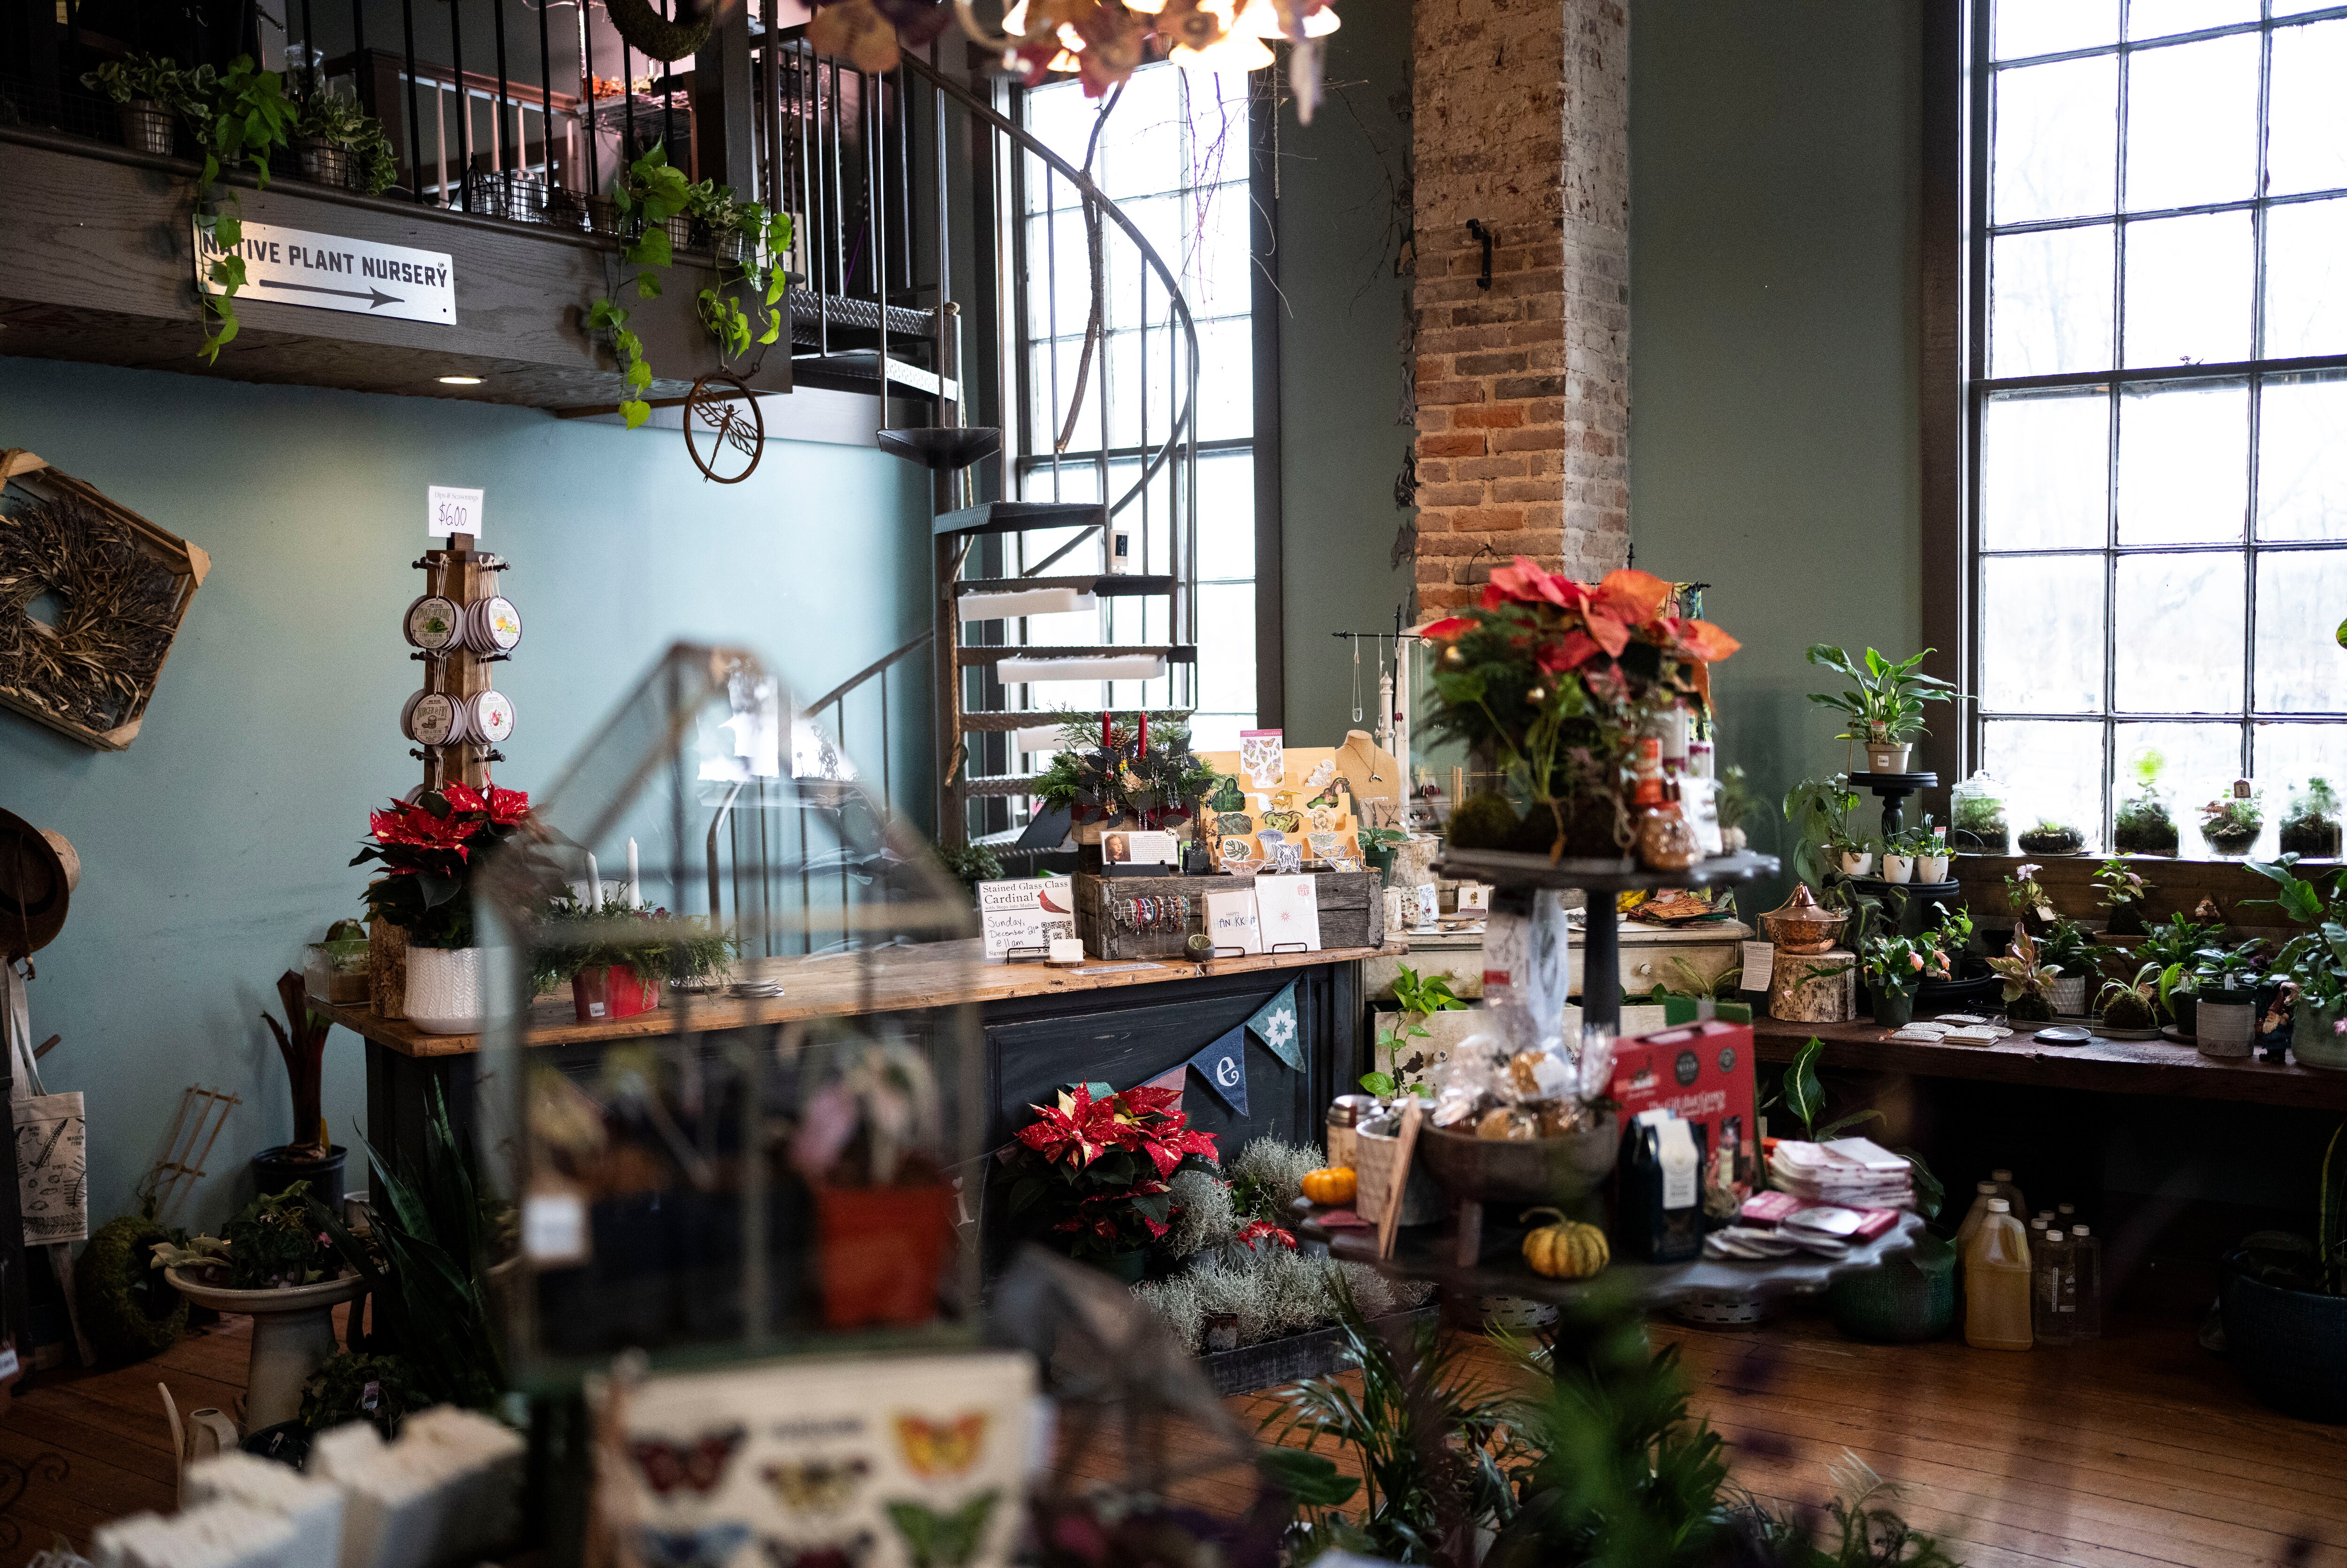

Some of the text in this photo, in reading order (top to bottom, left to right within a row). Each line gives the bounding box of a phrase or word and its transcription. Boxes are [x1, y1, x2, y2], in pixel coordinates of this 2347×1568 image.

[289, 245, 354, 275] PLANT
[362, 256, 447, 288] NURSERY
[435, 491, 445, 500] Dips
[452, 493, 479, 502] Seasonings
[417, 706, 434, 720] BURGER
[438, 706, 449, 718] FRY
[983, 880, 1068, 893] Stained Glass Class
[984, 892, 1034, 904] Cardinal
[988, 917, 1025, 928] Sunday,
[989, 929, 1025, 938] December
[1216, 1056, 1240, 1087] e
